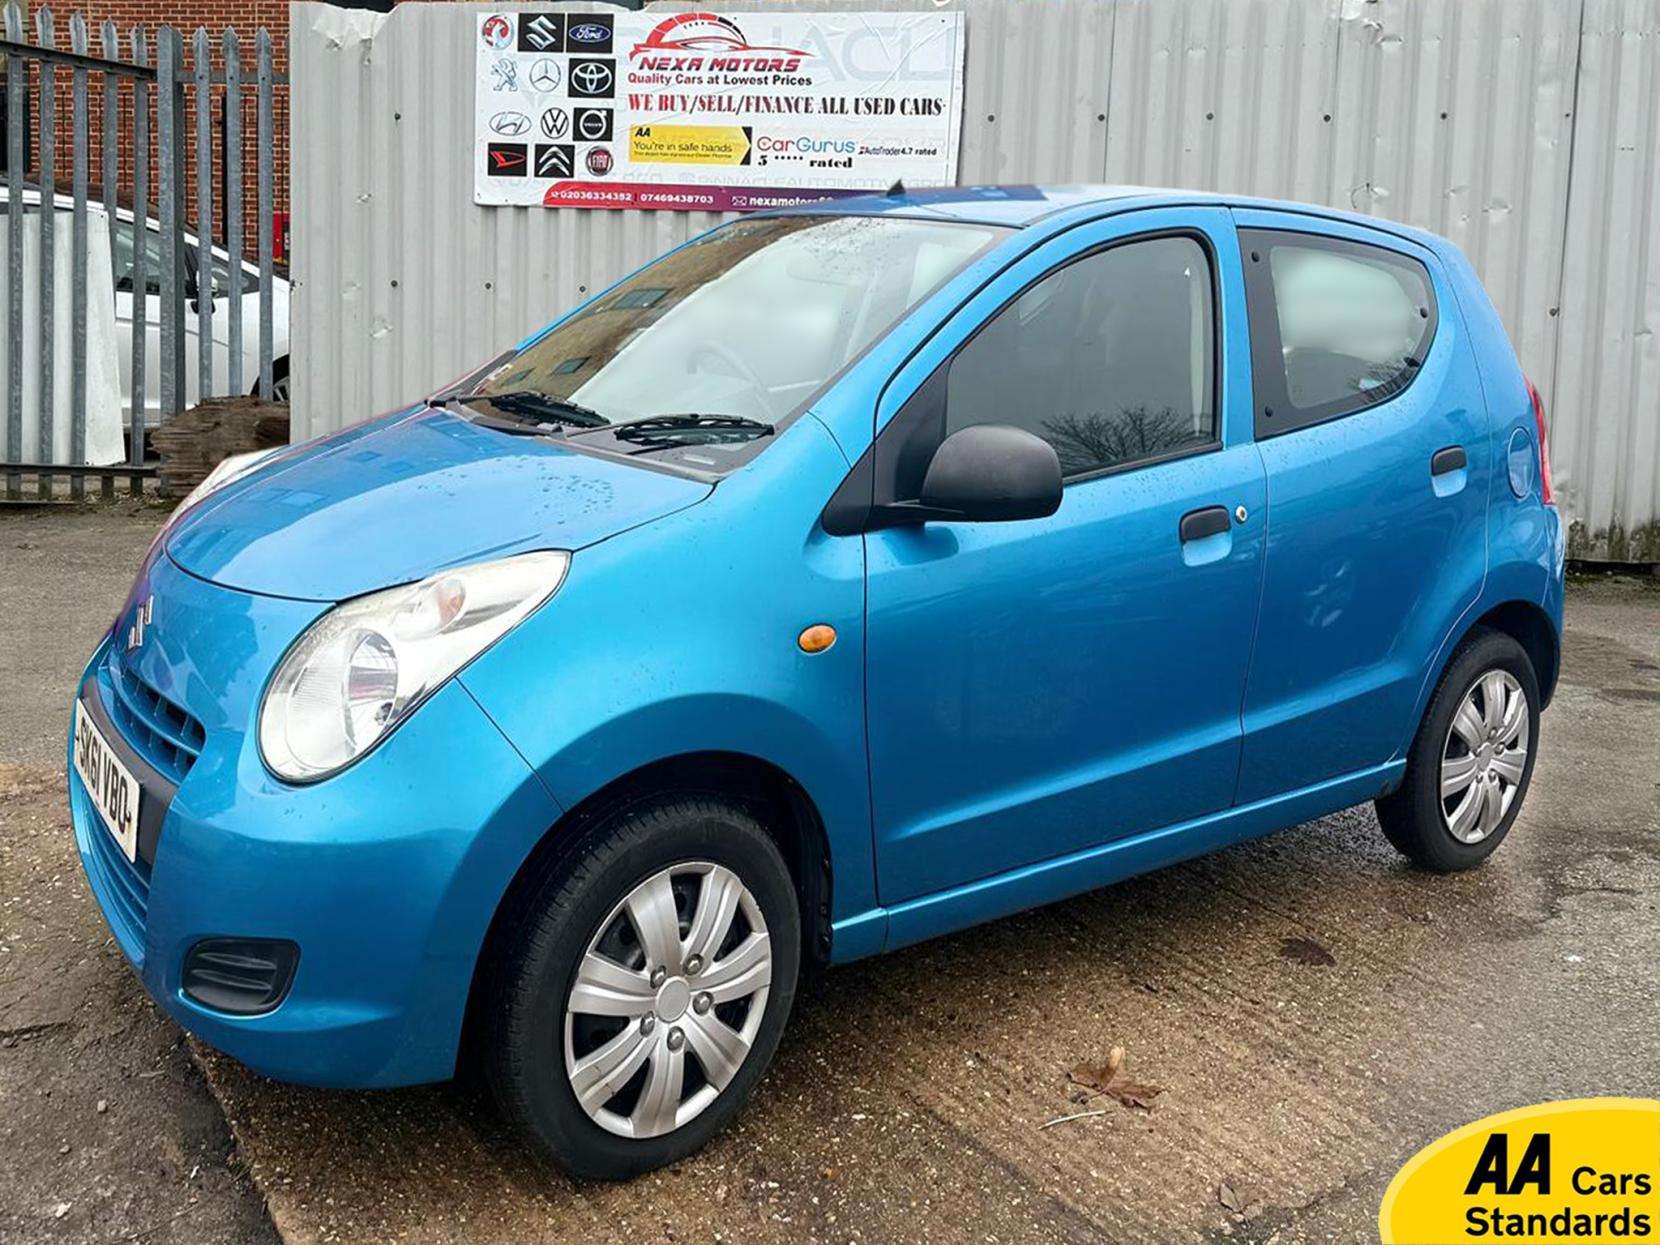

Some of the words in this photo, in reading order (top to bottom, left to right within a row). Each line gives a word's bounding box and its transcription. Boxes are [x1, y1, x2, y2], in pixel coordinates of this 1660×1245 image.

[638, 57, 705, 71] NEXA
[708, 58, 802, 73] MOTORS
[628, 73, 672, 86] Quality
[675, 73, 703, 85] Cars
[707, 74, 720, 85] at
[724, 74, 768, 86] Lowest
[772, 75, 812, 86] Prices
[628, 93, 653, 112] WE
[658, 93, 814, 115] BUY/SELL/FINANCE
[818, 96, 849, 115] ALL
[853, 97, 896, 116] USED
[900, 97, 943, 116] CARS
[635, 127, 651, 137] AA
[633, 141, 665, 151] You're
[667, 142, 676, 150] in
[678, 142, 699, 152] safe
[701, 142, 733, 153] hands
[757, 136, 855, 153] CarGurus
[915, 147, 938, 156] rated
[758, 155, 768, 166] 5
[809, 157, 853, 168] rated
